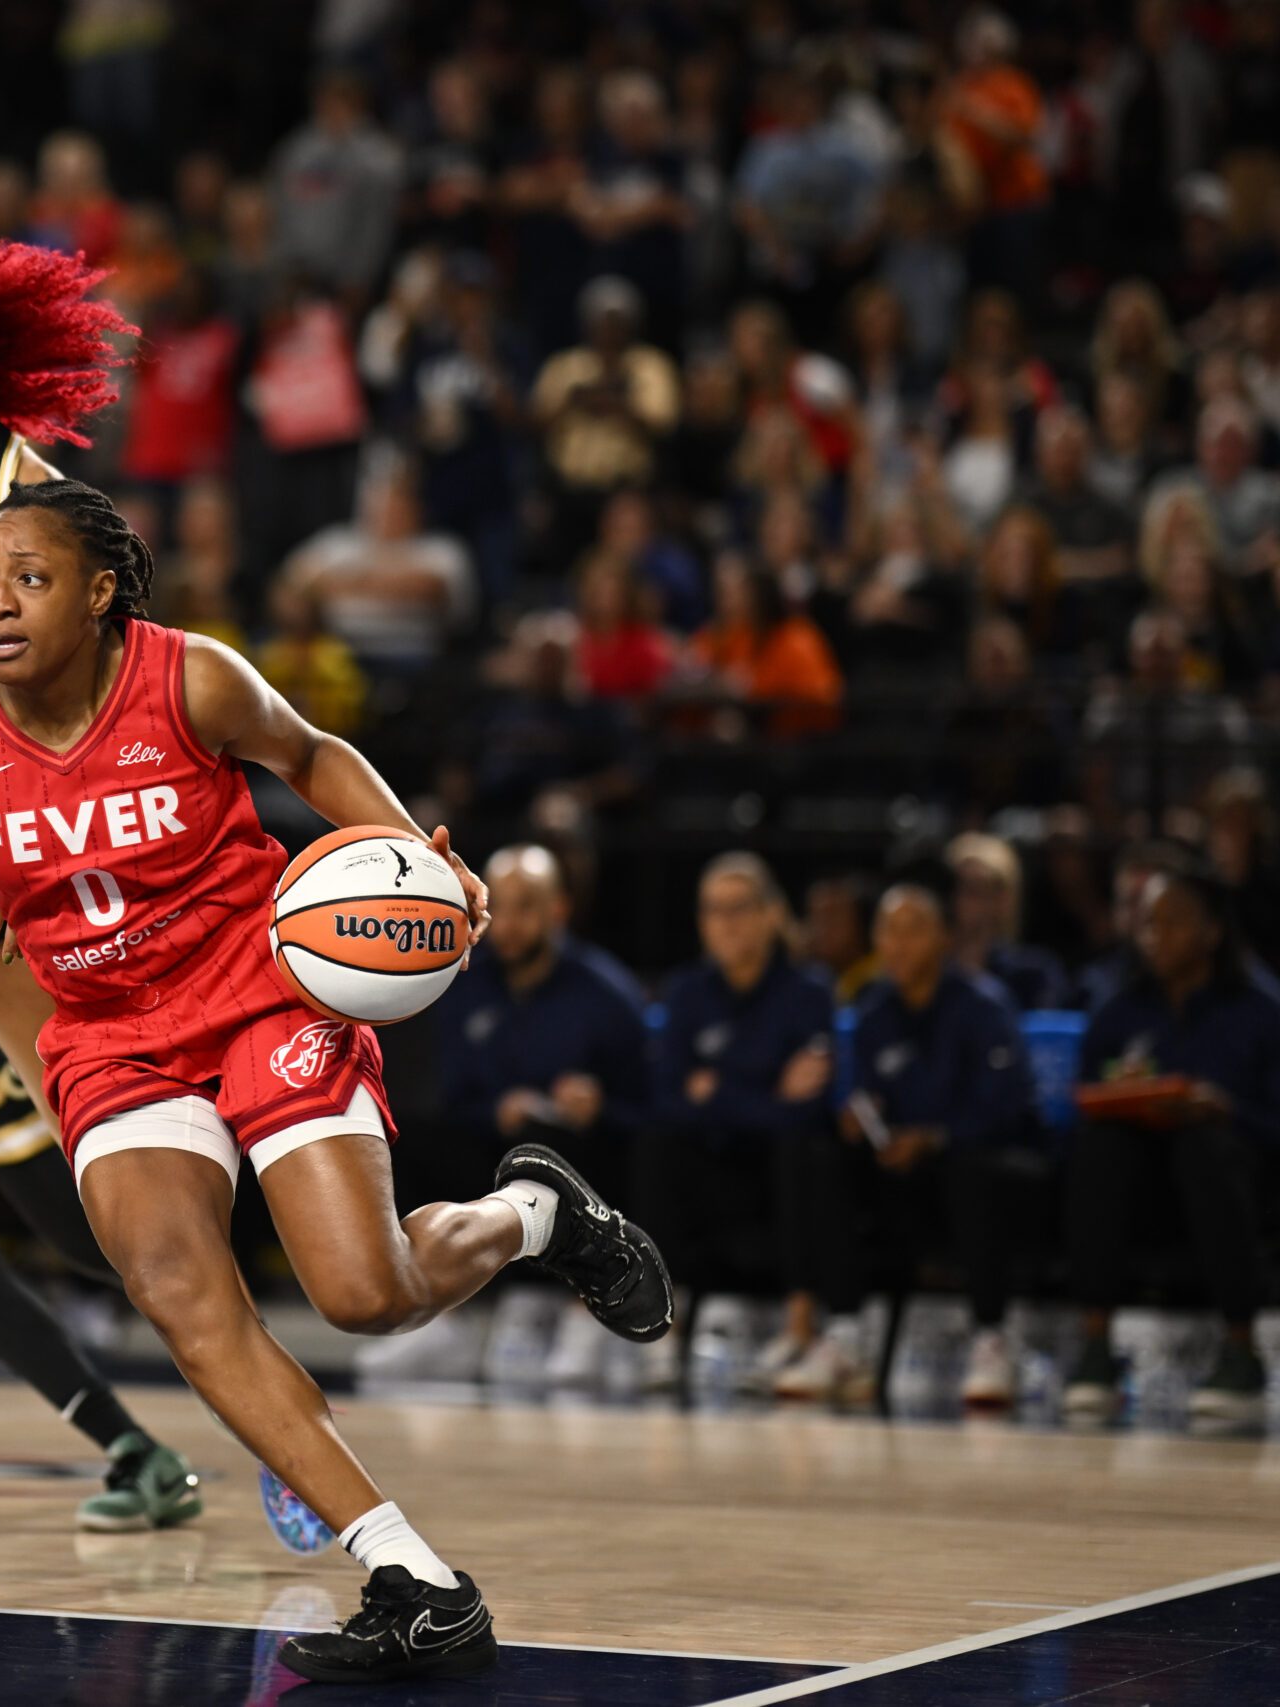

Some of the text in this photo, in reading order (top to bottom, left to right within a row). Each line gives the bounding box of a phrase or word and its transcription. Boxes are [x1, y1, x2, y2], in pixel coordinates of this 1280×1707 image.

[116, 741, 166, 767] Lilly
[70, 867, 125, 927] 0
[333, 913, 456, 953] Wilson
